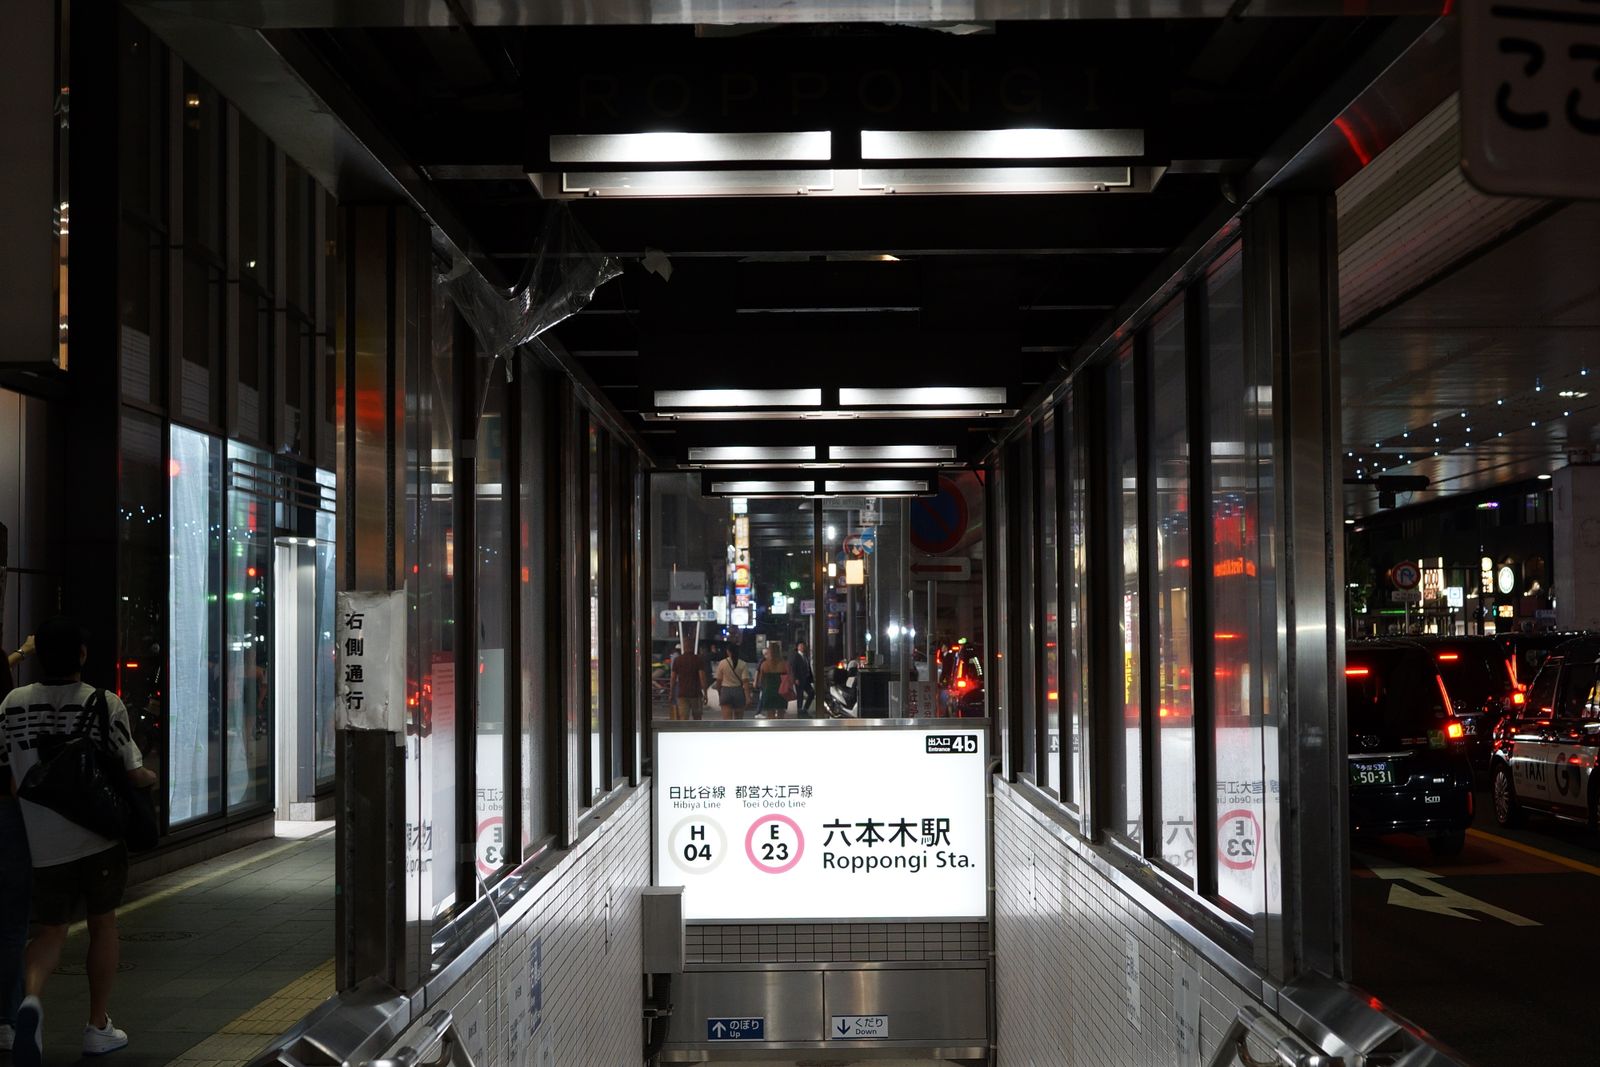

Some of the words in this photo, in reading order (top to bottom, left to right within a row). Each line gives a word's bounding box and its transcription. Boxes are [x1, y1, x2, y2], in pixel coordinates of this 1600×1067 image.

[576, 66, 1103, 118] ROPPONGI
[344, 612, 364, 711] 右側通行
[928, 737, 951, 746] 出入口
[952, 735, 976, 752] 4b
[1373, 763, 1385, 771] 530
[1525, 756, 1545, 782] TAXI
[1360, 771, 1392, 784] 50-31
[669, 786, 726, 800] 日比谷線
[735, 785, 813, 799] 都営大江戸線
[1425, 795, 1441, 803] km
[673, 800, 701, 810] Hibiya
[703, 800, 722, 808] Line
[742, 800, 760, 808] Toei
[762, 800, 785, 808] Oedo
[788, 800, 806, 808] Line
[690, 825, 705, 840] H
[770, 825, 780, 840] E
[822, 817, 951, 848] 六本木駅
[683, 844, 712, 861] 04
[761, 843, 789, 860] 23
[823, 851, 927, 873] Roppongi
[936, 851, 975, 868] Sta.
[729, 1019, 760, 1030] のぼり
[855, 1018, 883, 1028] くだり
[729, 1030, 741, 1039] Up
